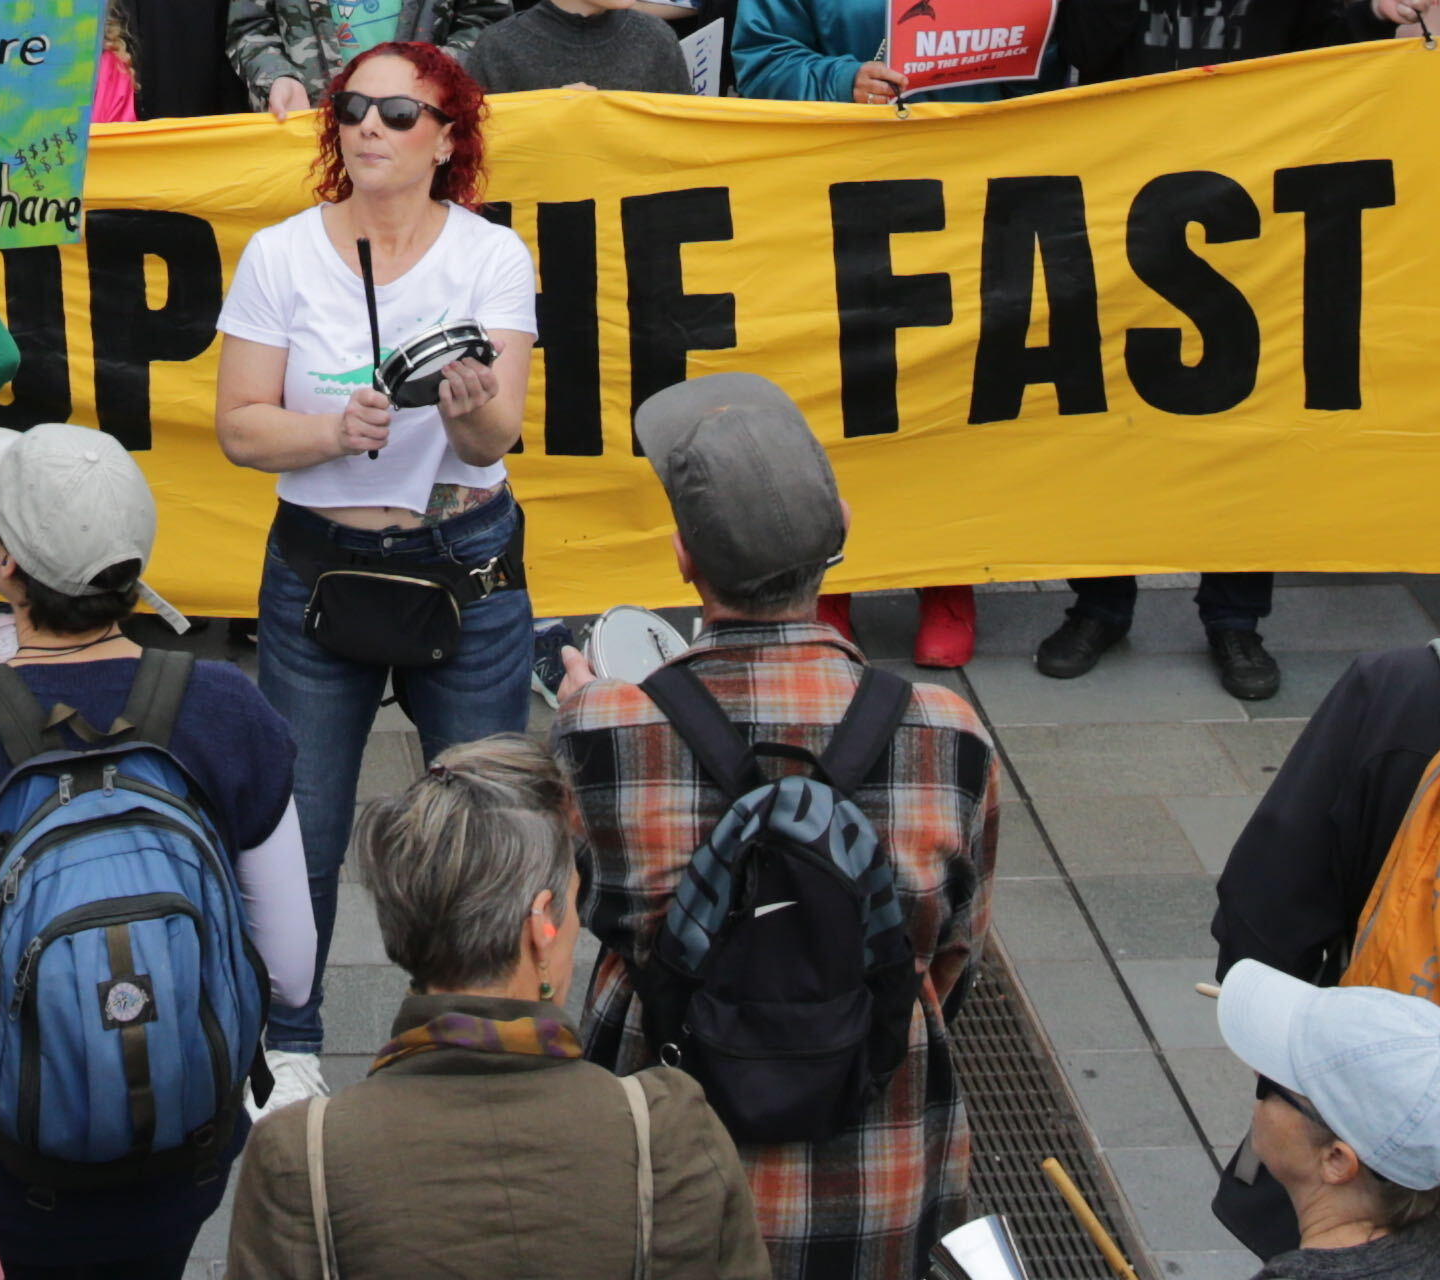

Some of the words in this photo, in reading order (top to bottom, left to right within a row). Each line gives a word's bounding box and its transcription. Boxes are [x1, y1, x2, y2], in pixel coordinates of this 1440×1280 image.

[916, 26, 1025, 57] NATURE
[482, 186, 737, 456] HE
[830, 159, 1395, 440] FAST
